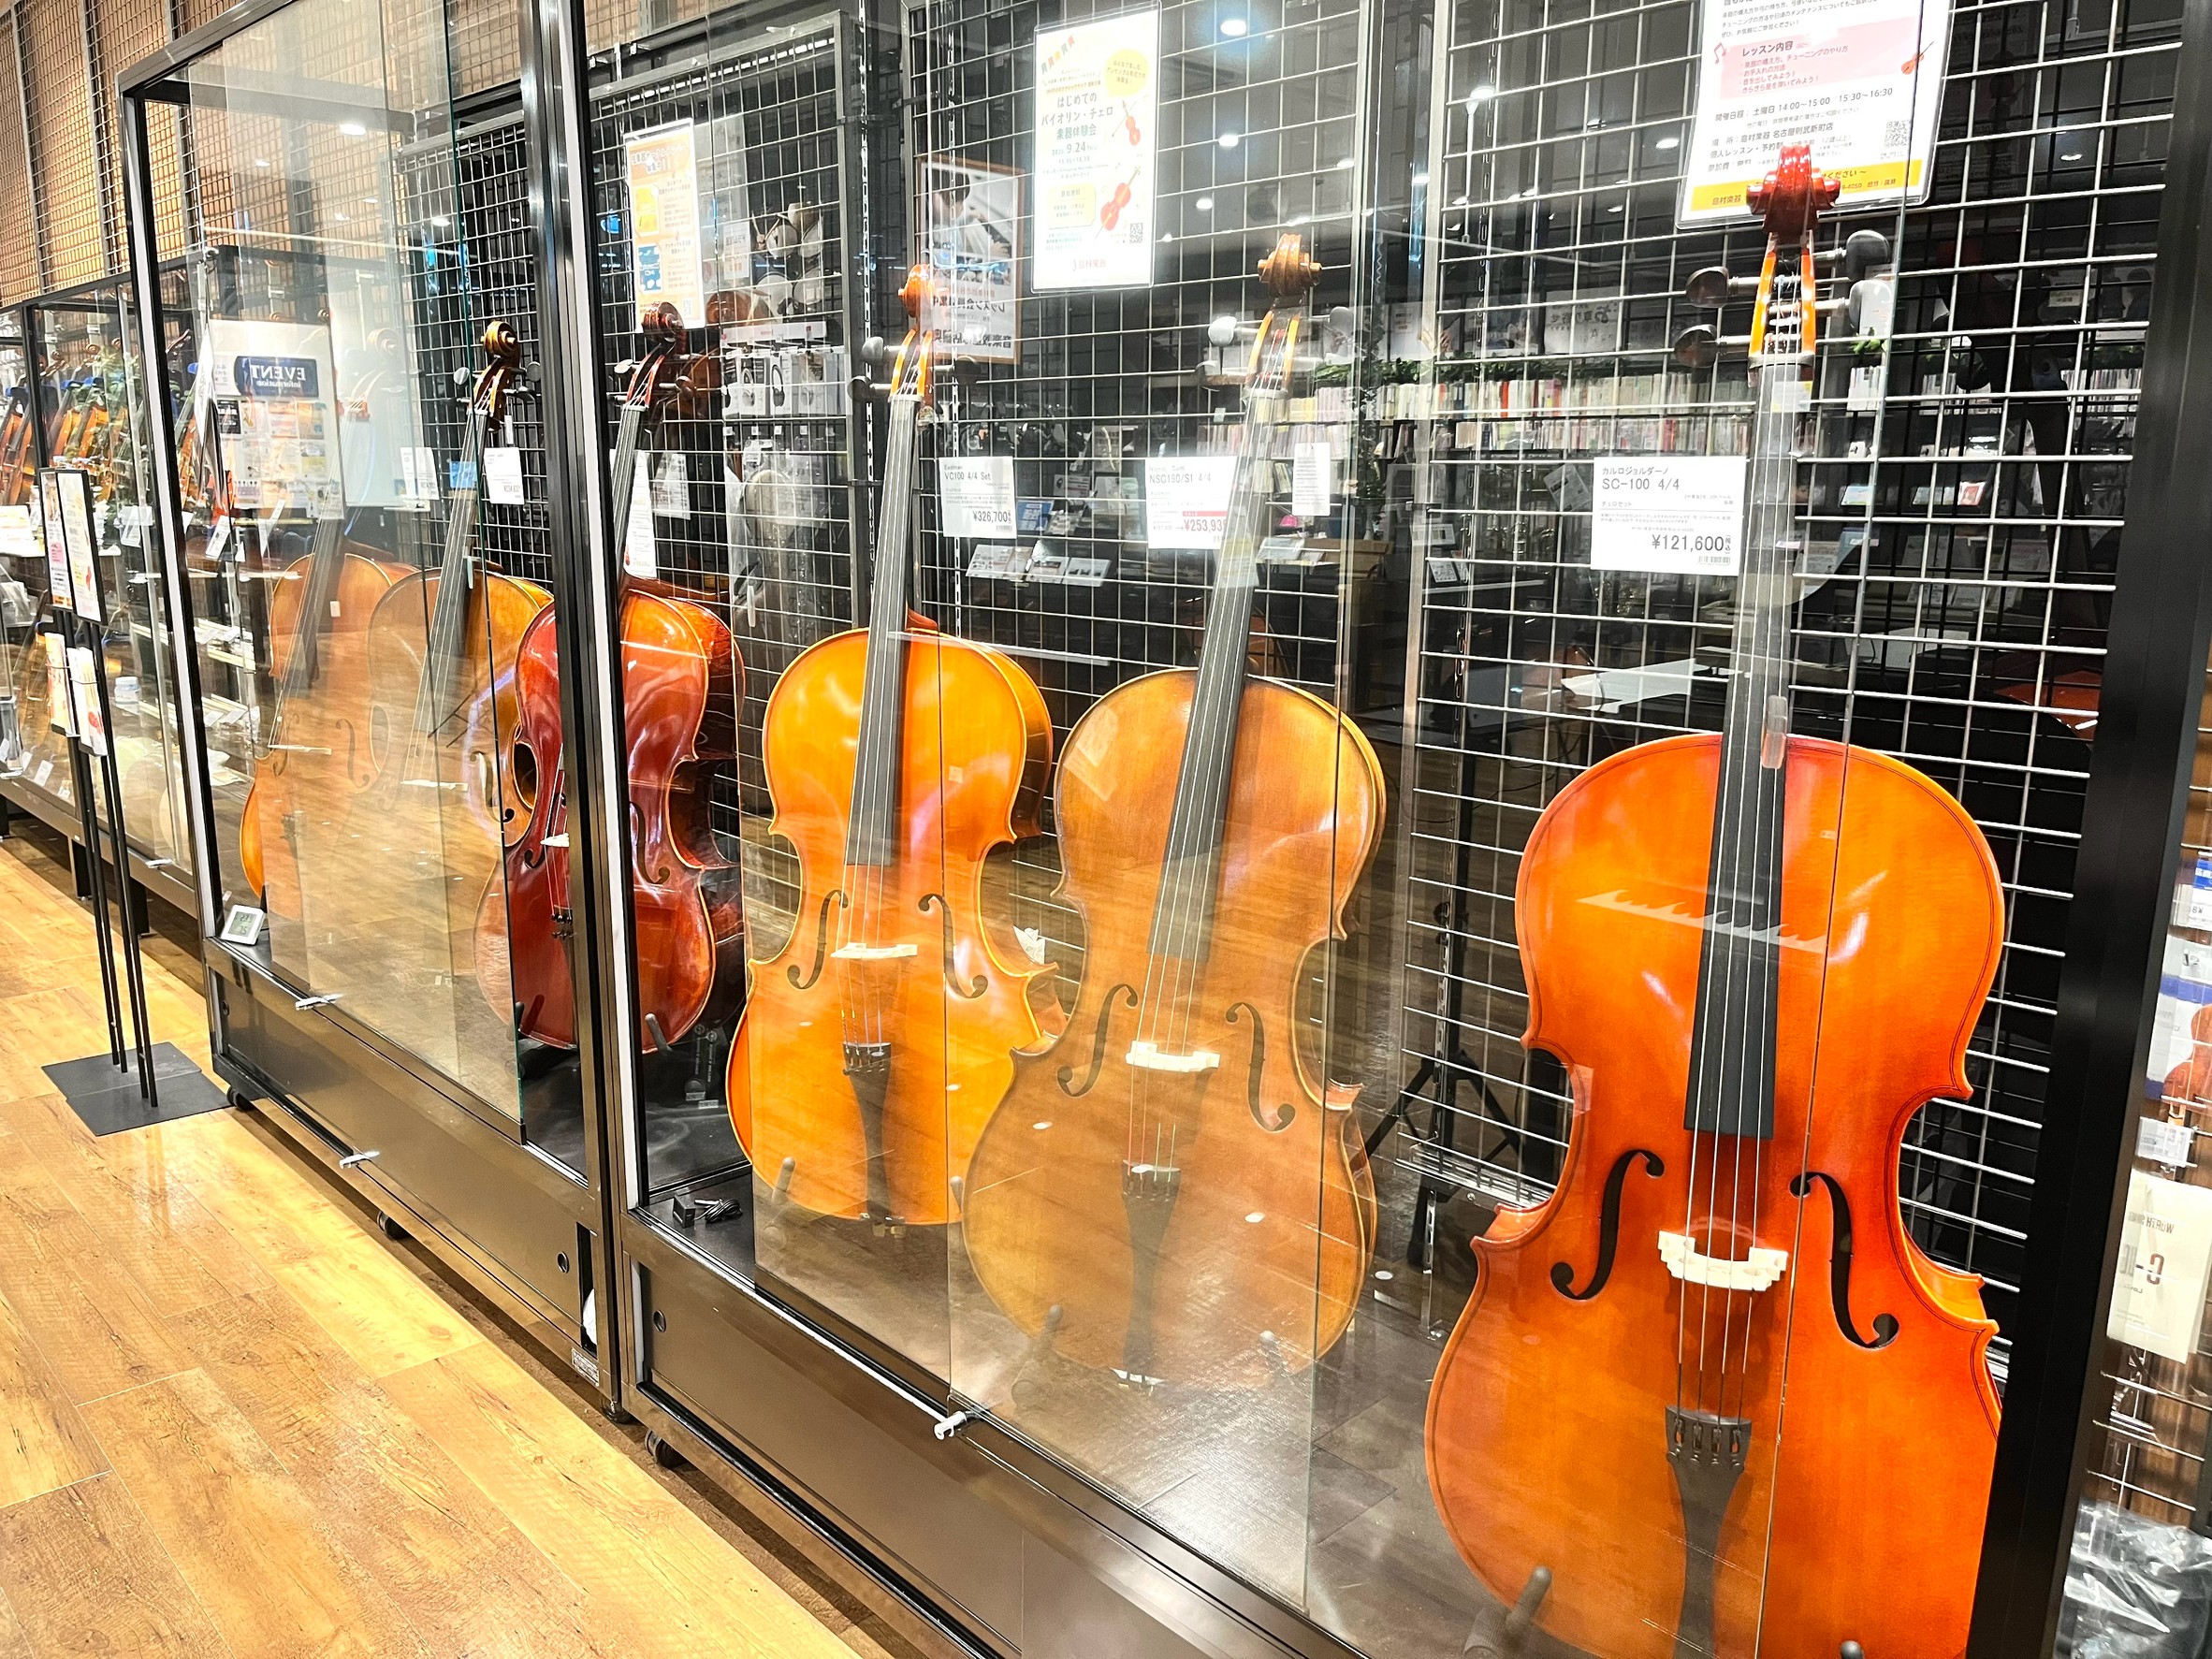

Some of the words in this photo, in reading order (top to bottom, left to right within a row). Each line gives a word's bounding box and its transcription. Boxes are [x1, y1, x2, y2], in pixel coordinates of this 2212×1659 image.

[1742, 41, 1794, 57] レッスン内容
[1056, 92, 1098, 109] はじめての
[1041, 106, 1113, 126] バイオリン・チェロ
[1056, 123, 1097, 140] 楽器体験会
[1066, 141, 1086, 154] 9.24
[944, 472, 965, 480] VC100
[967, 472, 978, 480] 4/4
[981, 472, 992, 481] Set
[1601, 466, 1669, 476] カルロジョルダーノ
[1601, 478, 1651, 490] SC-100
[1657, 478, 1681, 491] 4/4
[973, 511, 1008, 523] ¥326,700
[1651, 533, 1724, 553] ¥121,600
